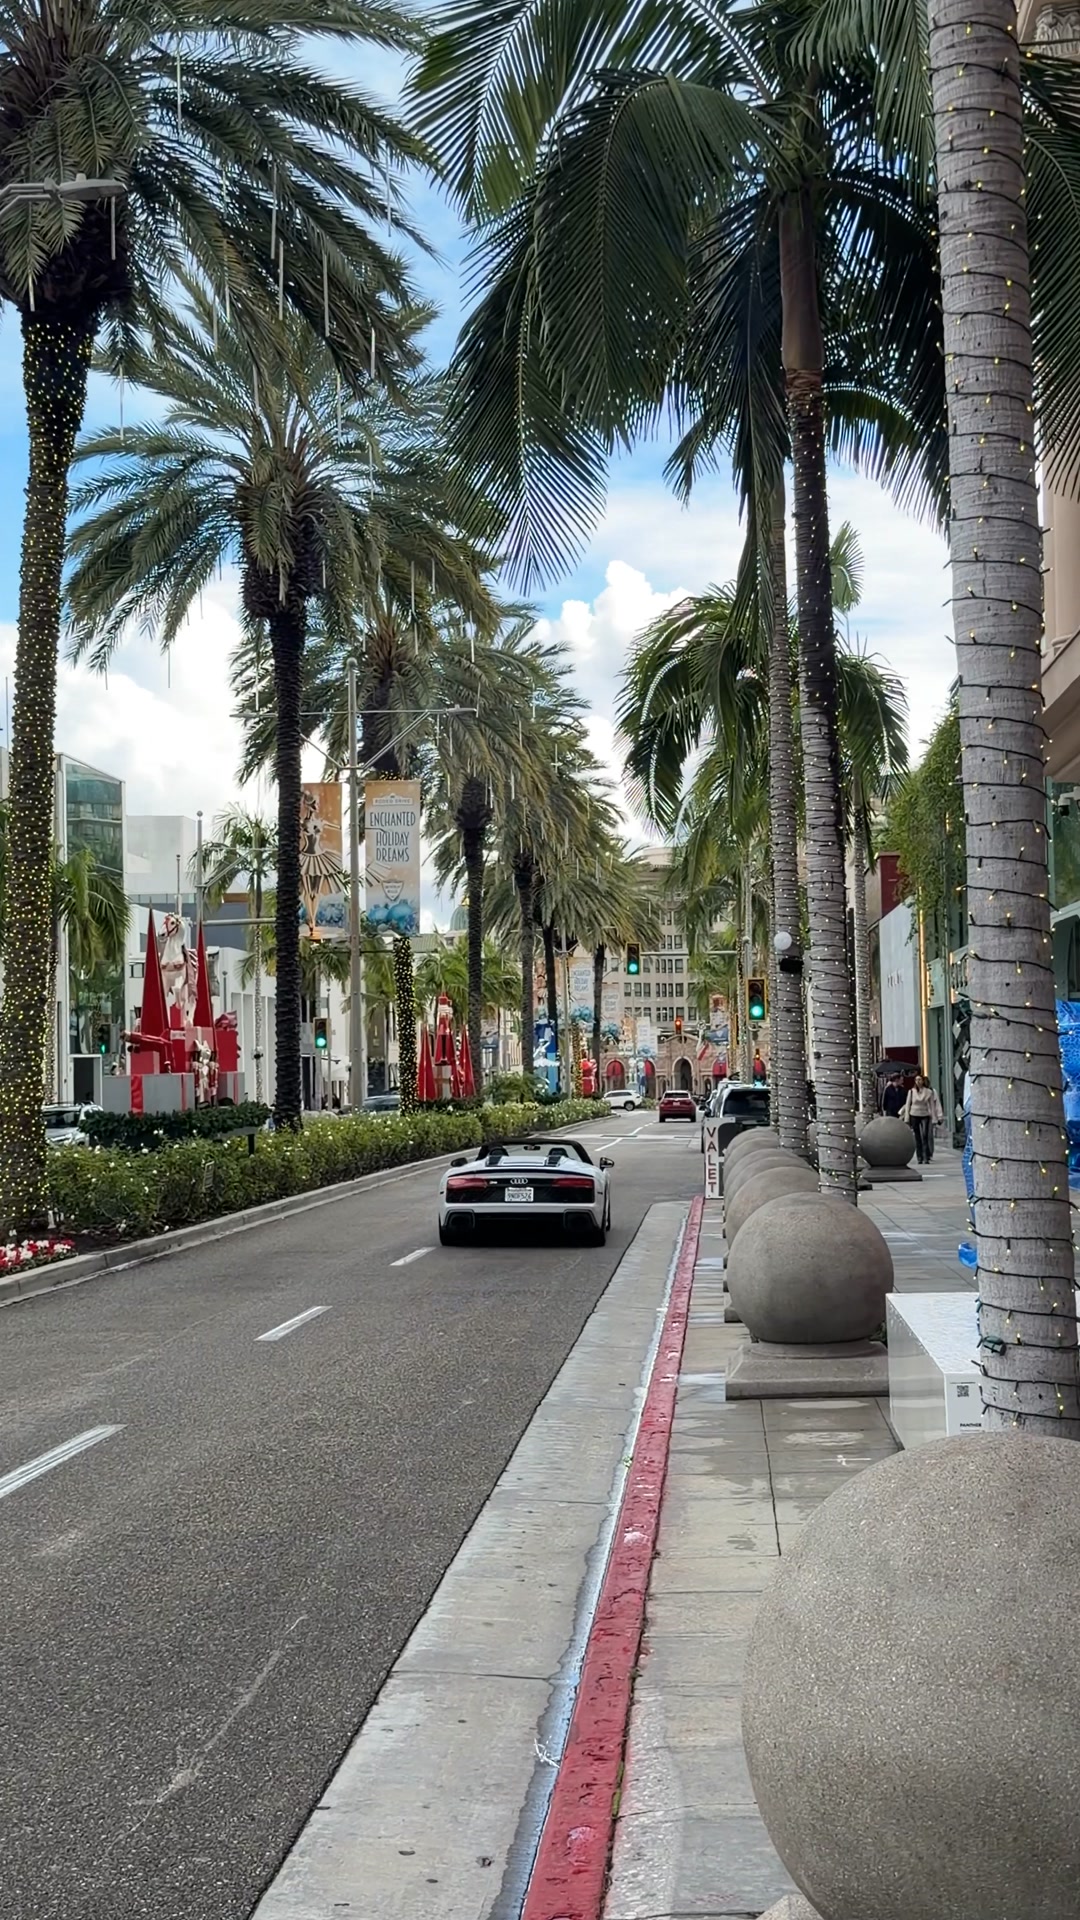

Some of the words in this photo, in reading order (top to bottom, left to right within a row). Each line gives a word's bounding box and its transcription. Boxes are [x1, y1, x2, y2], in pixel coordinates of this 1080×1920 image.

[370, 812, 416, 827] ENCHANTED
[376, 831, 410, 847] HOLIDAY
[376, 847, 410, 862] DREAMS
[706, 1126, 717, 1193] VALET
